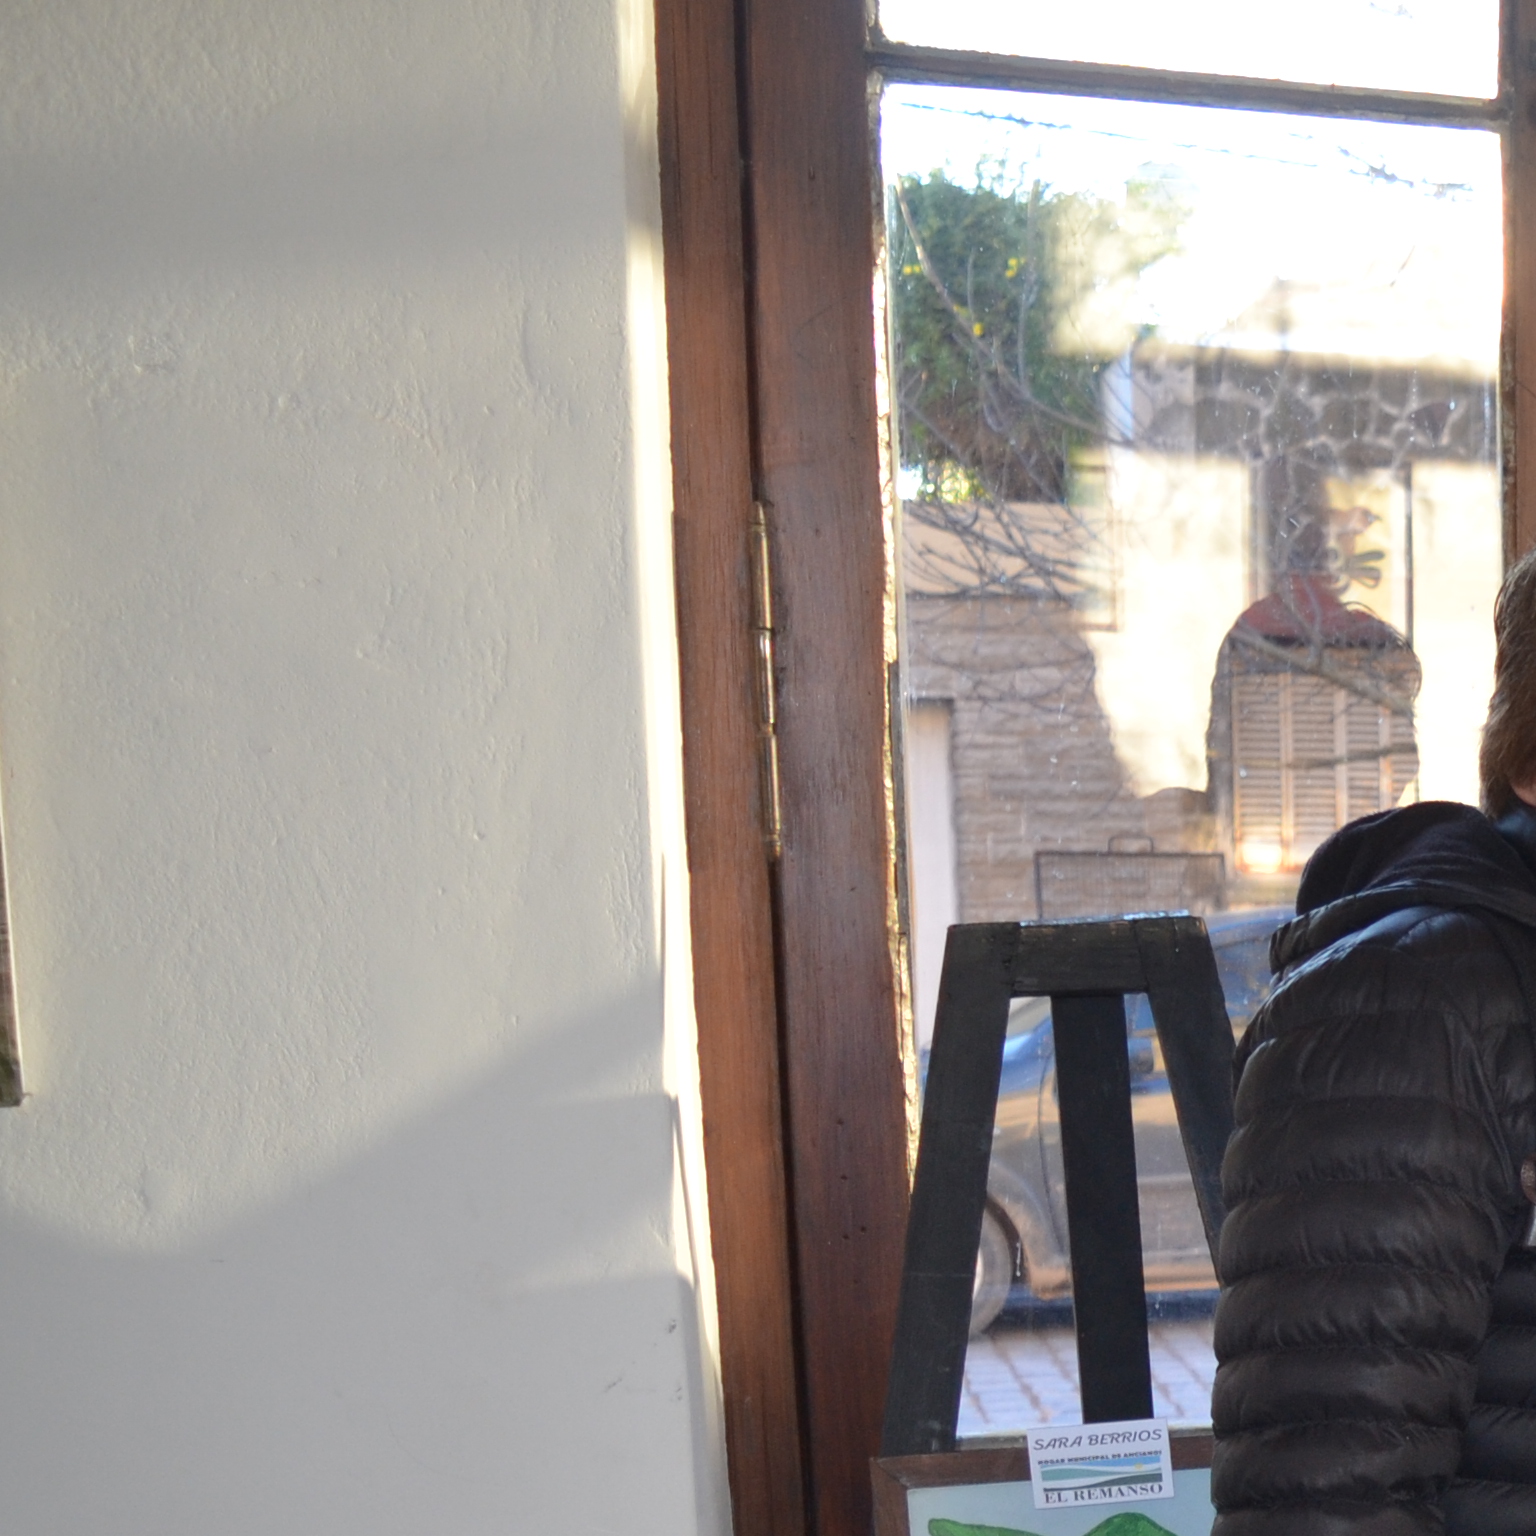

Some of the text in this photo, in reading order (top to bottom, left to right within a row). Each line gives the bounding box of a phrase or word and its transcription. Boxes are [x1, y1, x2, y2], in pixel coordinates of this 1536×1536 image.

[1033, 1428, 1162, 1451] SARA BERRIOS
[1067, 1454, 1110, 1464] MUNICIPAL
[1123, 1450, 1162, 1459] ANCIANOS
[1044, 1484, 1163, 1504] EL REMANSO
